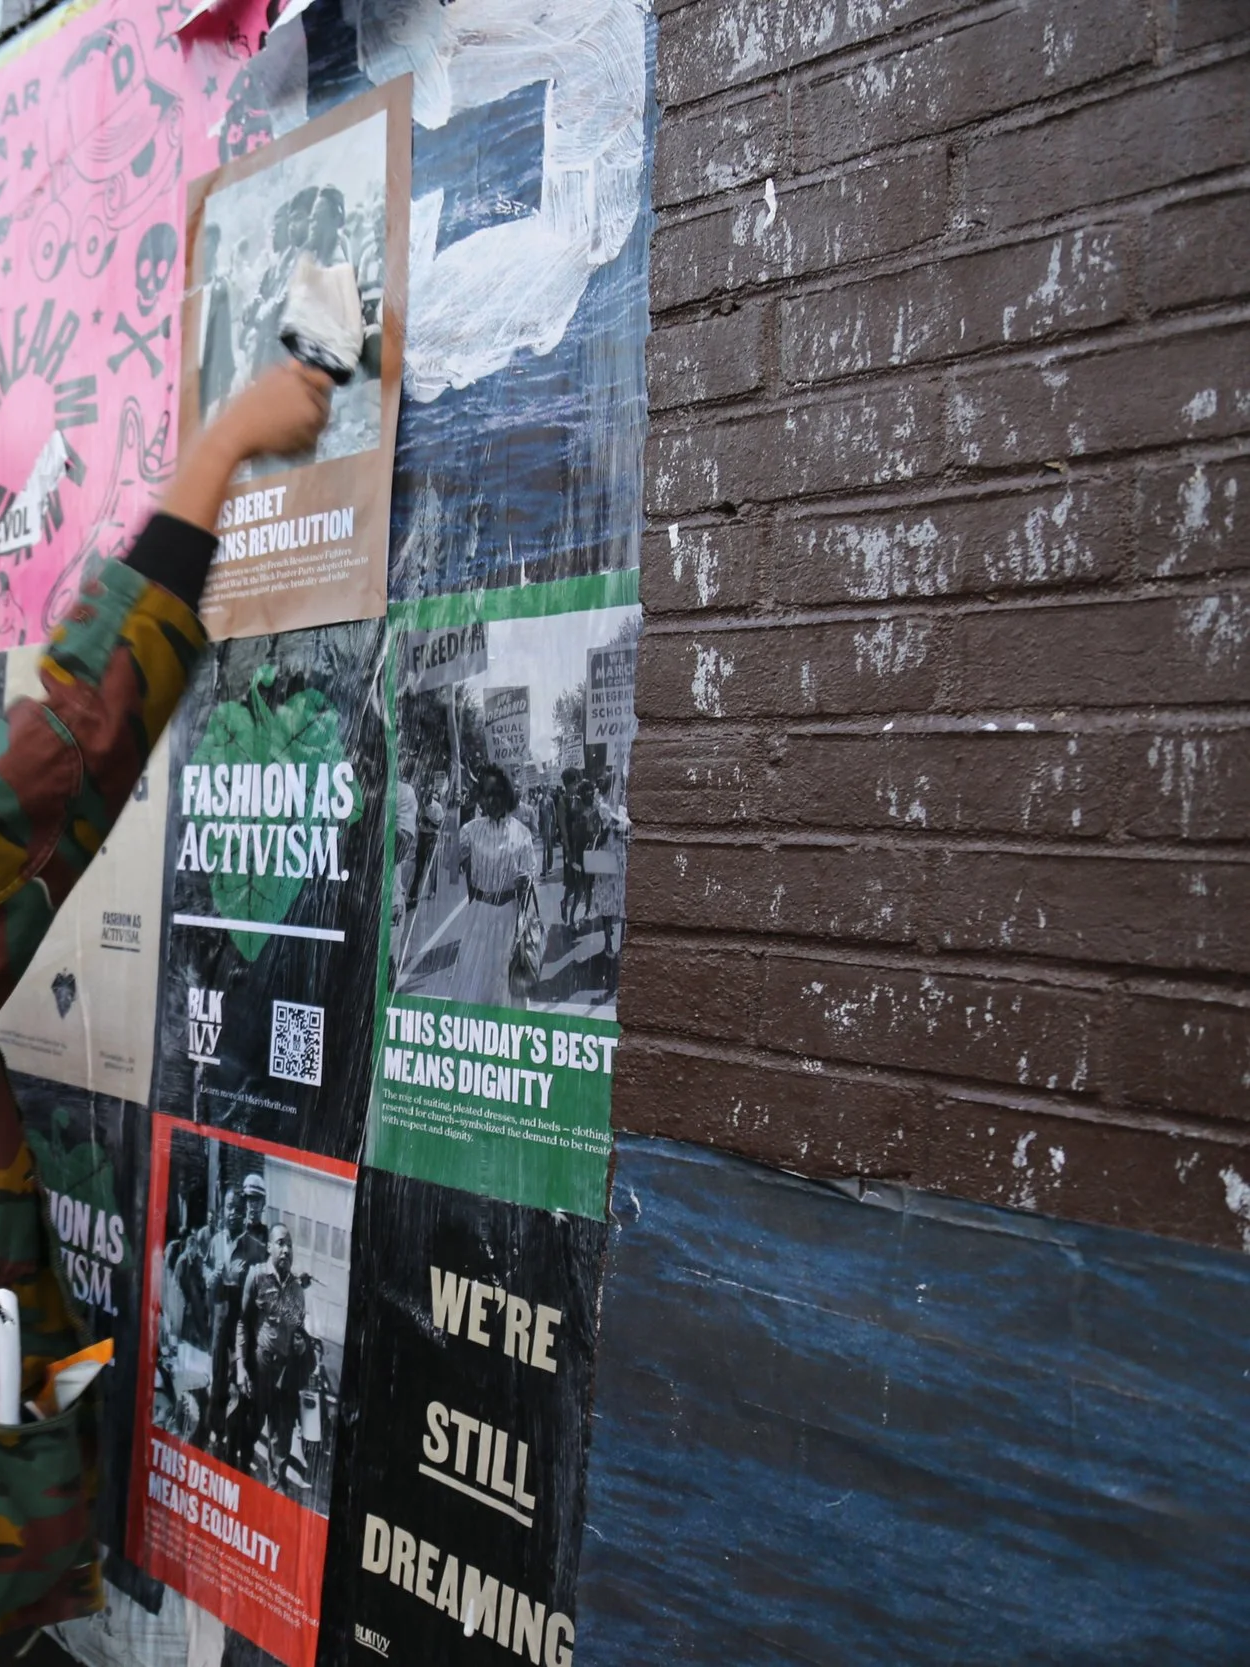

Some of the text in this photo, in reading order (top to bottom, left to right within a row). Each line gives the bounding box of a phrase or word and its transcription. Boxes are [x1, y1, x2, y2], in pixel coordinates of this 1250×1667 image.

[234, 485, 287, 526] BERET
[249, 506, 354, 557] REVOLUTION
[325, 547, 352, 560] Fighters
[491, 723, 524, 735] EQUAL
[591, 705, 631, 719] SCHOO
[494, 743, 527, 760] NOW!
[182, 763, 308, 818] FASHION
[311, 761, 355, 820] AS
[176, 821, 350, 882] ACTIVISM.
[188, 986, 224, 1023] BLK
[188, 1020, 223, 1056] IVY
[386, 1007, 619, 1075] THIS SUNDAY'S BEST
[200, 1083, 219, 1097] Learn
[383, 1047, 554, 1109] MEANS DIGNITY
[382, 1087, 398, 1100] The
[413, 1095, 423, 1104] of
[423, 1098, 452, 1112] suiting,
[453, 1103, 483, 1117] pleated
[483, 1107, 517, 1125] dresses,
[519, 1116, 536, 1127] and
[571, 1125, 610, 1144] clothing
[382, 1114, 474, 1143] with respect and dignity.
[415, 1106, 427, 1118] for
[507, 1127, 522, 1139] the
[522, 1129, 558, 1146] demand
[559, 1137, 570, 1148] to
[571, 1138, 583, 1151] be
[92, 1209, 125, 1265] AS
[430, 1265, 562, 1374] WE'RE
[151, 1438, 241, 1513] THIS DENIM
[422, 1401, 536, 1510] STILL
[148, 1471, 199, 1524] MEANS
[201, 1502, 281, 1573] EQUALITY
[361, 1512, 576, 1667] DREAMING
